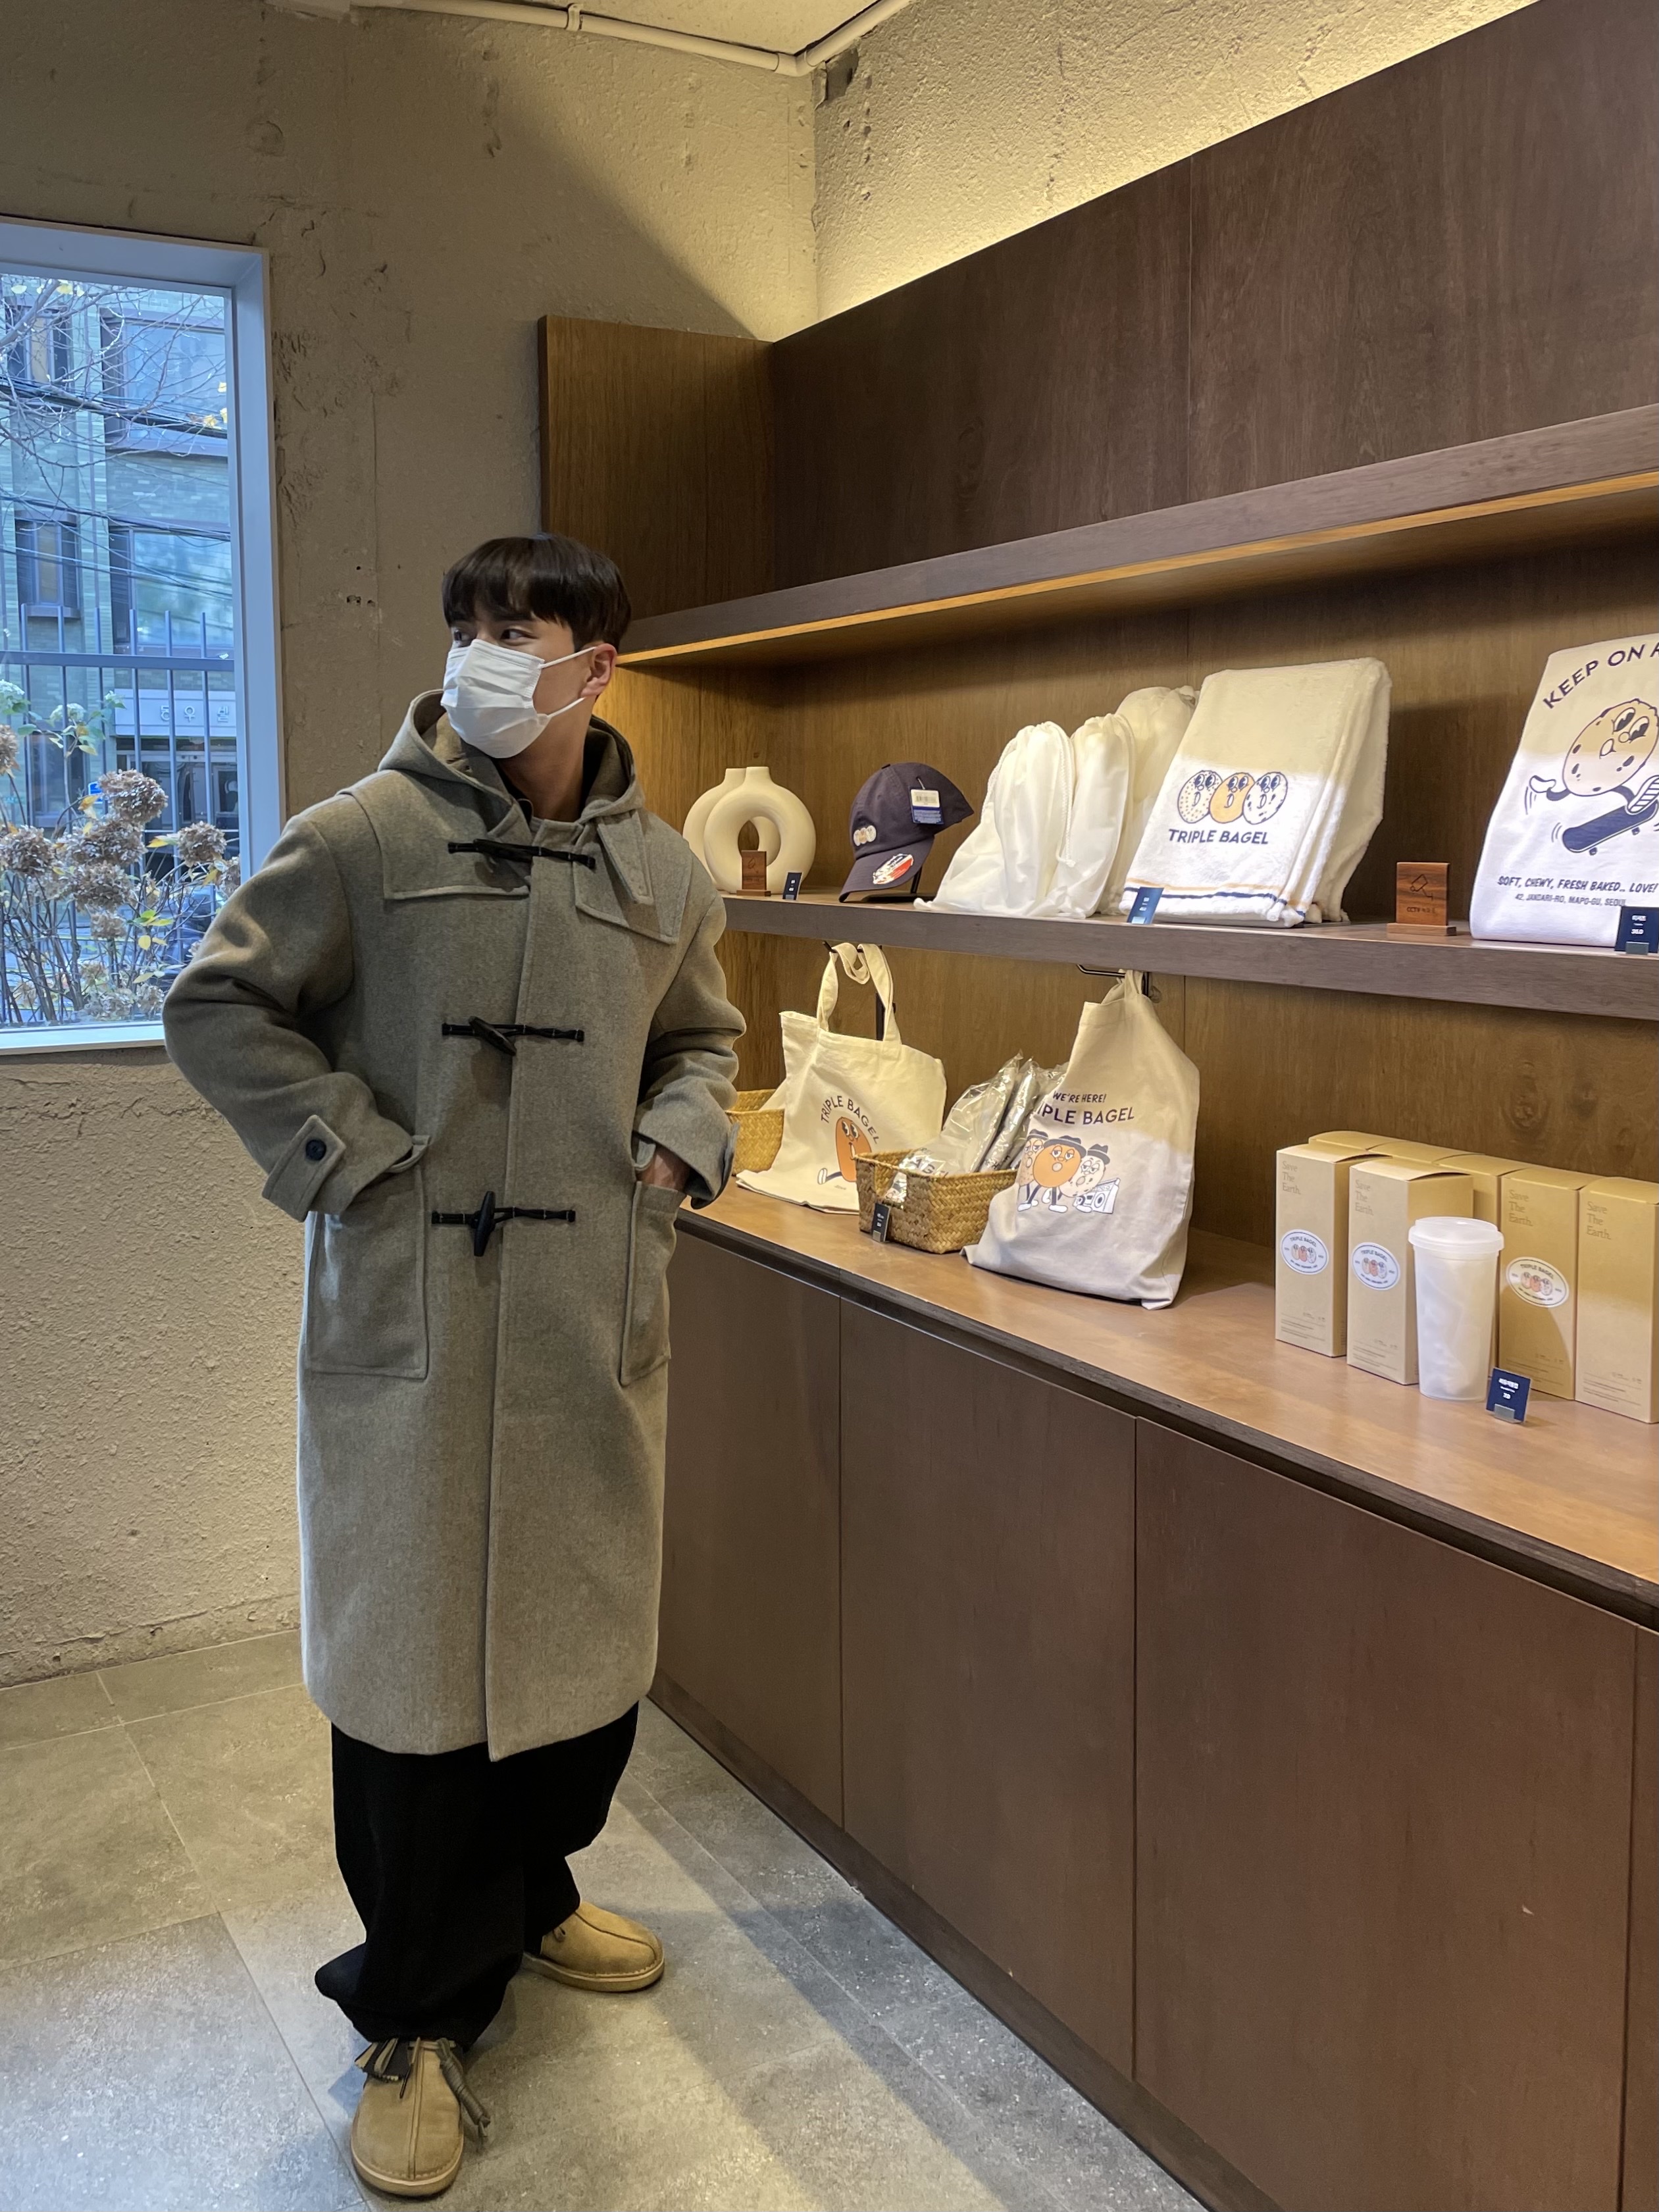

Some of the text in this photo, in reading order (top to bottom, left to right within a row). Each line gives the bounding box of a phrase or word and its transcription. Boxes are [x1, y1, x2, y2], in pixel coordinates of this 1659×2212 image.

[1543, 660, 1599, 709] KEEP
[1608, 644, 1646, 666] ON
[1169, 829, 1269, 844] TRIPLE BAGEL
[1498, 876, 1521, 888] SOFT,
[1525, 878, 1554, 889] CHEWY,
[1557, 879, 1589, 890] FRESH
[1629, 883, 1658, 893] LOVE!
[1053, 1091, 1107, 1103] WE'RE HERE!
[821, 1095, 879, 1145] TRIPLE BAGEL
[1037, 1102, 1135, 1125] IPLE BAGEL
